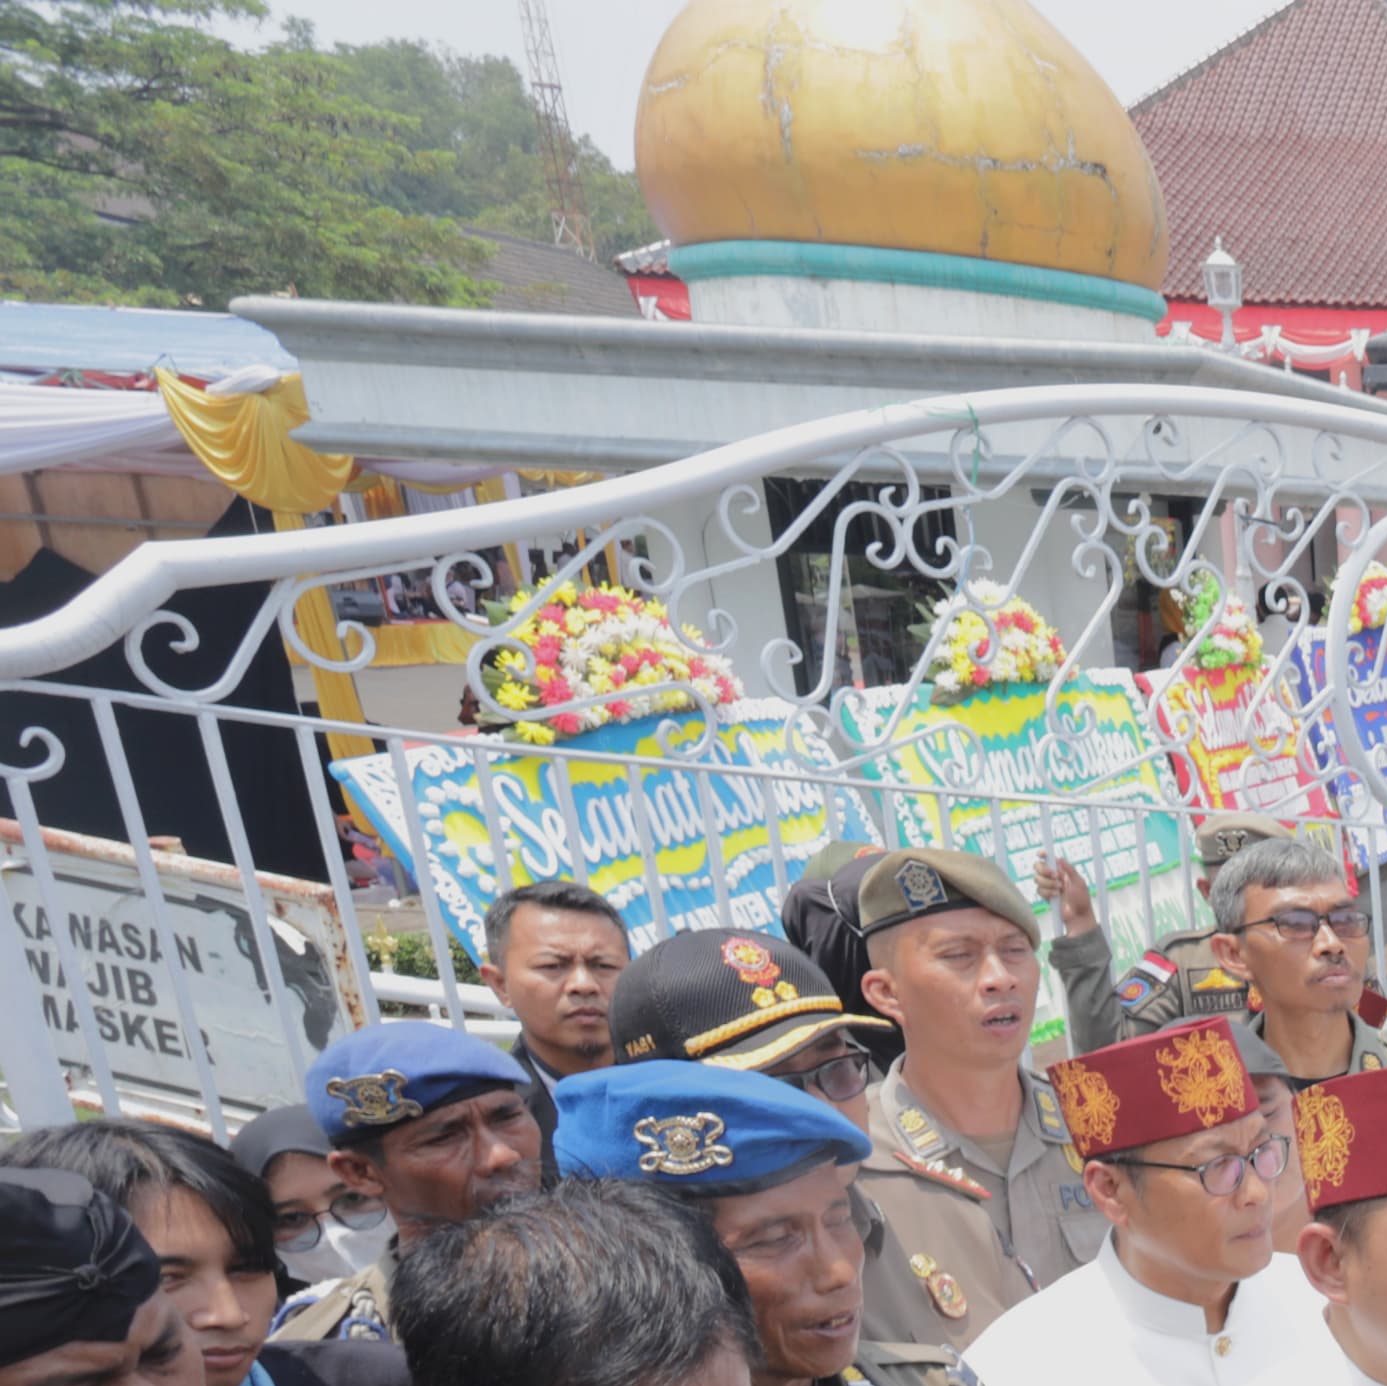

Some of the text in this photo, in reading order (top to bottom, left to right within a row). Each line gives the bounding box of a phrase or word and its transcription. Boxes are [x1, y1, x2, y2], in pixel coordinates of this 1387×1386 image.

[492, 763, 706, 877] Selamat
[25, 948, 157, 1007] WJIB
[1059, 1183, 1092, 1210] PO
